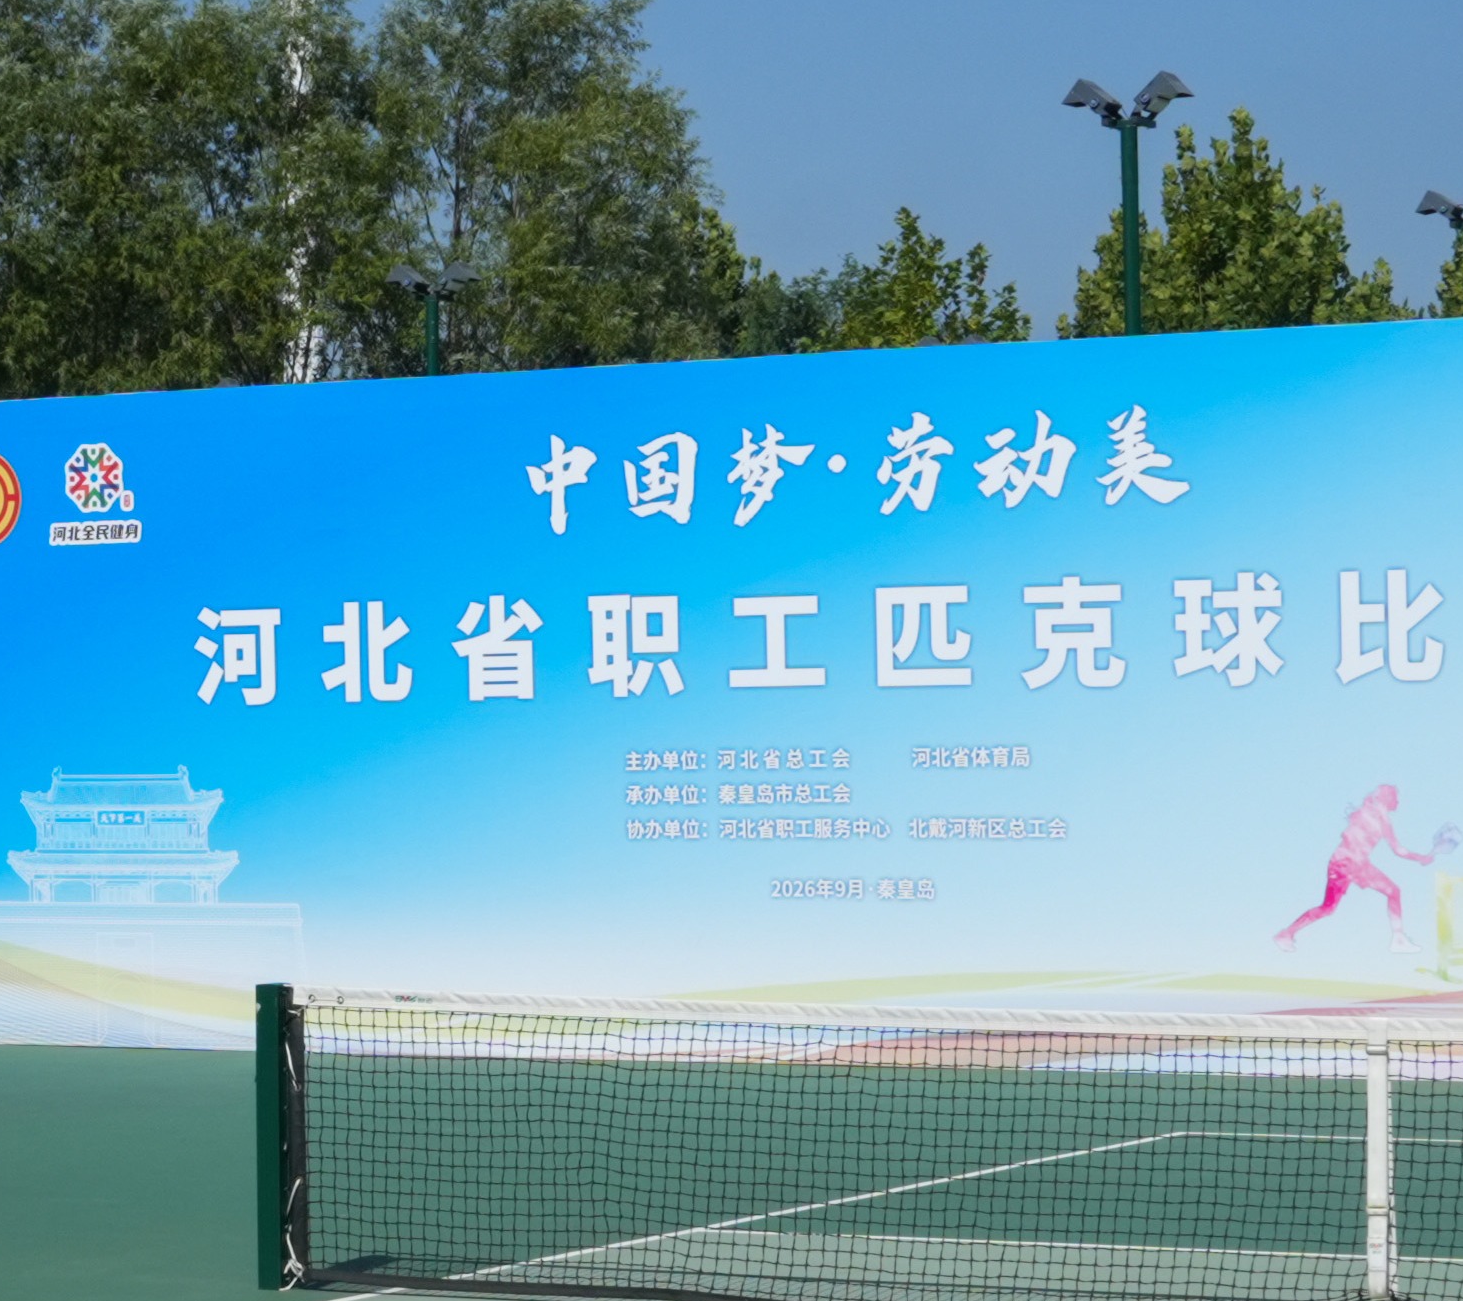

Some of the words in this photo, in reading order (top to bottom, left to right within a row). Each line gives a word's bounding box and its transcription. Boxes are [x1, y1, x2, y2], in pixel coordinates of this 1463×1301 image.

[526, 404, 1191, 535] 中国梦·劳动美
[53, 523, 139, 542] 河北全民健身
[912, 746, 1031, 769] 河北省体育局
[909, 817, 1068, 840] 北戴河新区总工会
